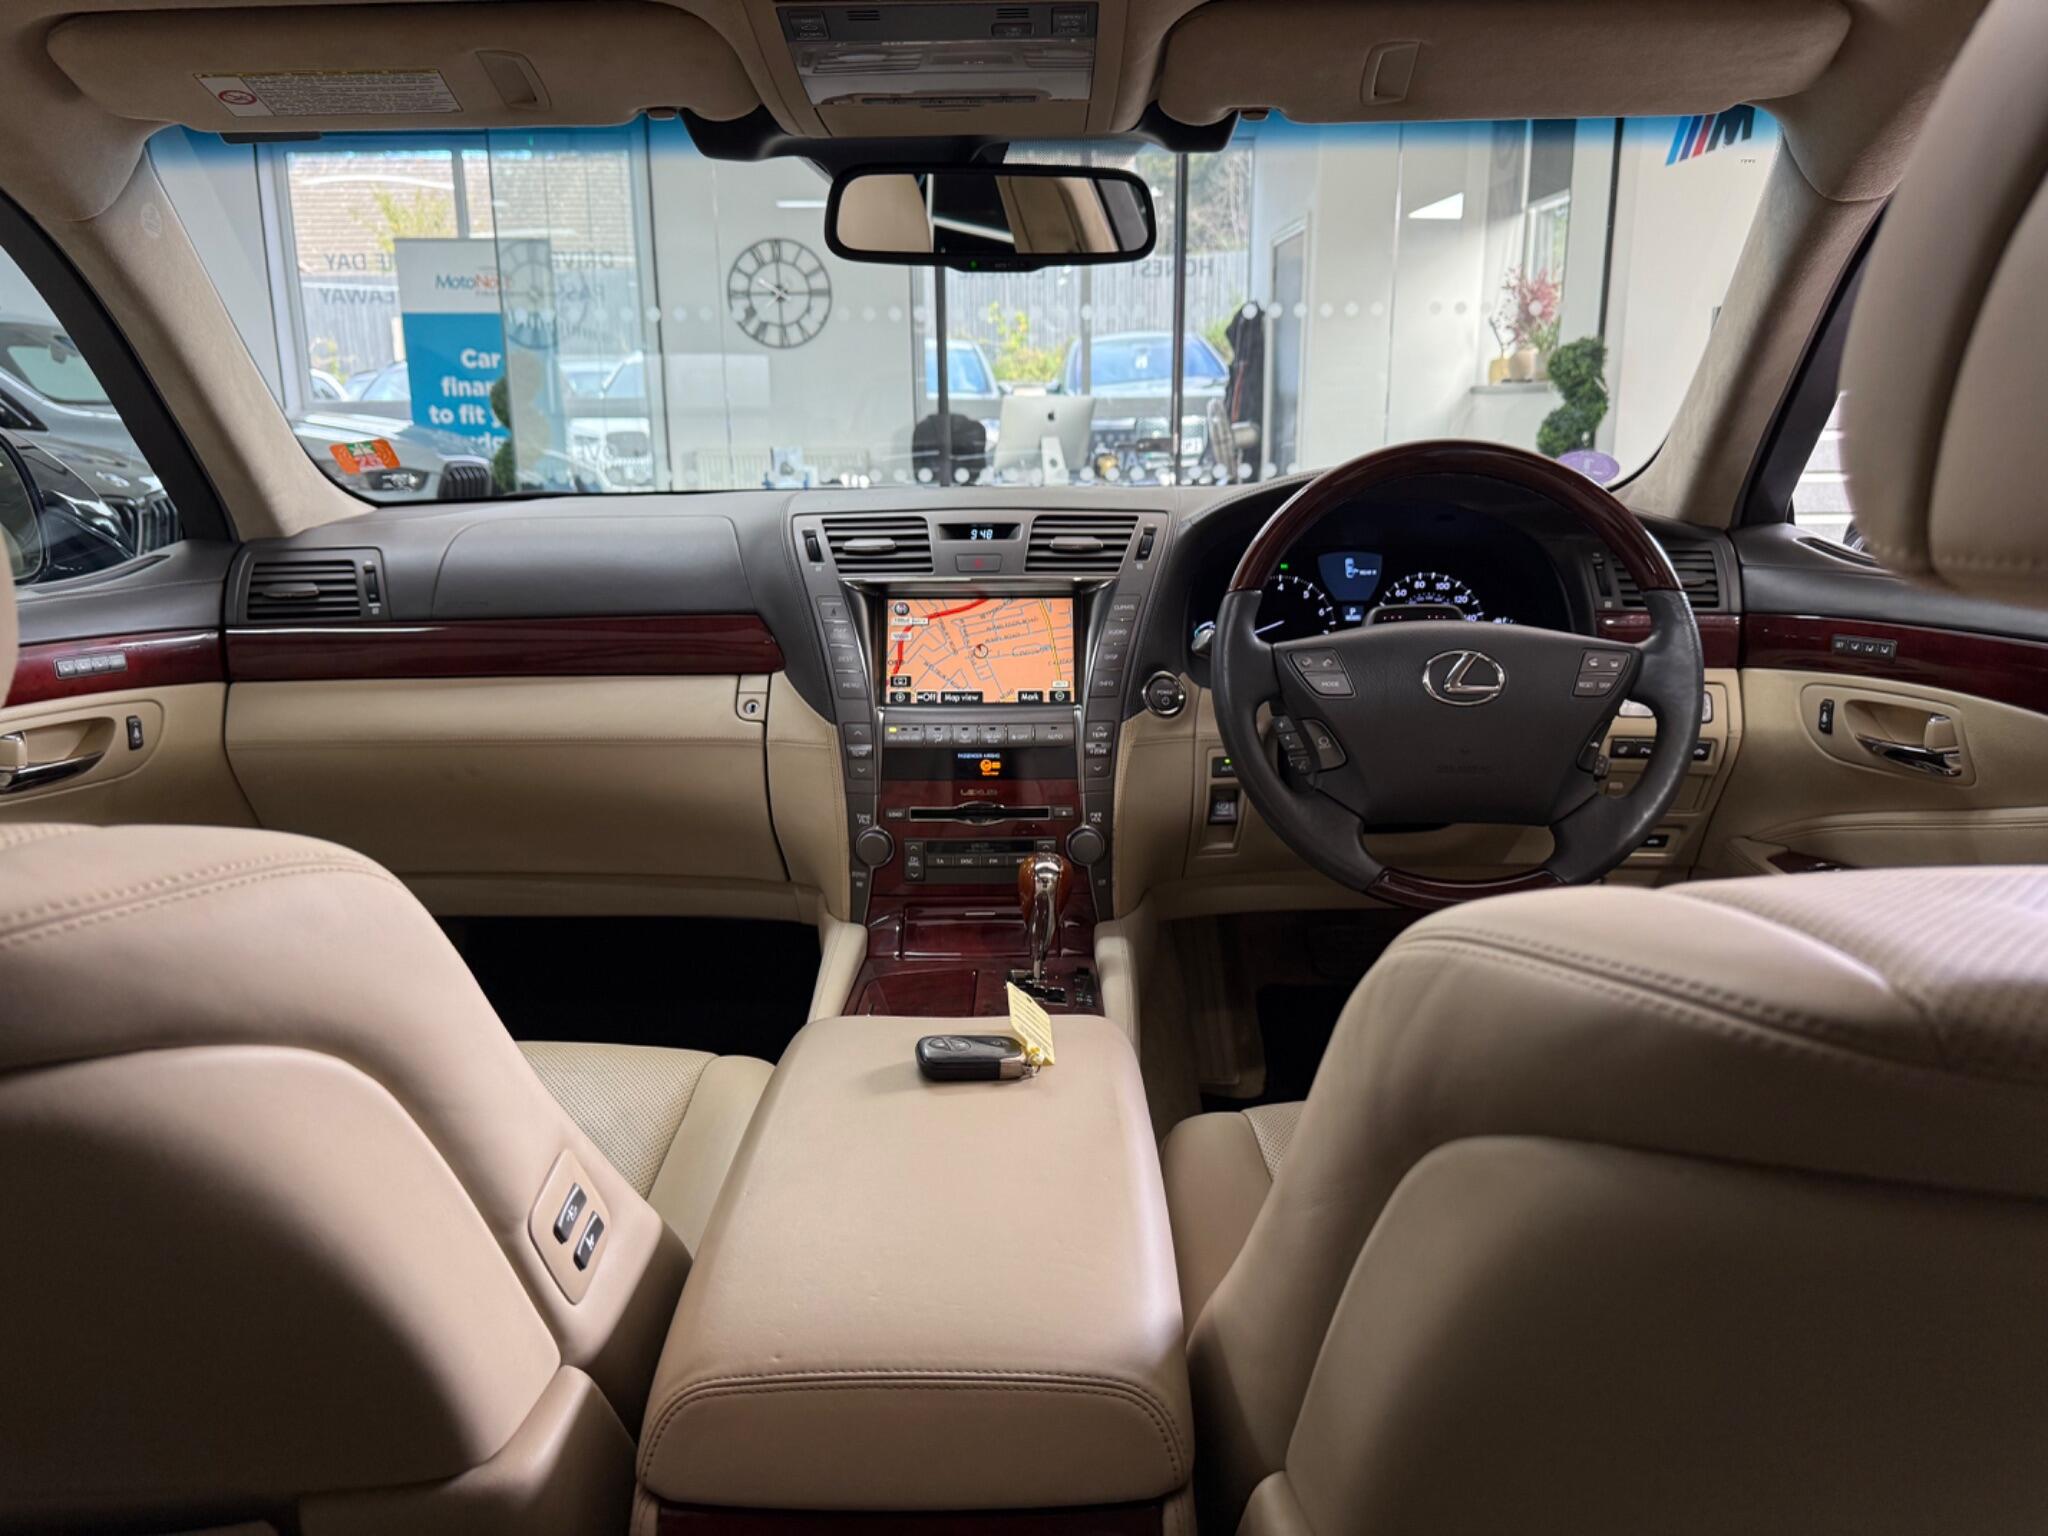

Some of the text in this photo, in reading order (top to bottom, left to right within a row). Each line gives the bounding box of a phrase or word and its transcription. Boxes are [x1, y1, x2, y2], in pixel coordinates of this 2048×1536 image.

[460, 348, 502, 369] Car
[441, 375, 496, 397] fina
[428, 404, 454, 424] to
[459, 403, 487, 425] fit
[1277, 583, 1284, 592] 4
[1414, 580, 1426, 590] 80
[1435, 581, 1452, 591] 100
[1303, 591, 1310, 600] 5
[1395, 588, 1408, 598] 60
[1454, 594, 1468, 604] 120
[1318, 608, 1325, 617] 6
[1321, 680, 1340, 688] MODE
[944, 693, 979, 703] Map view
[1021, 692, 1039, 701] Mark
[960, 857, 974, 865] DISC
